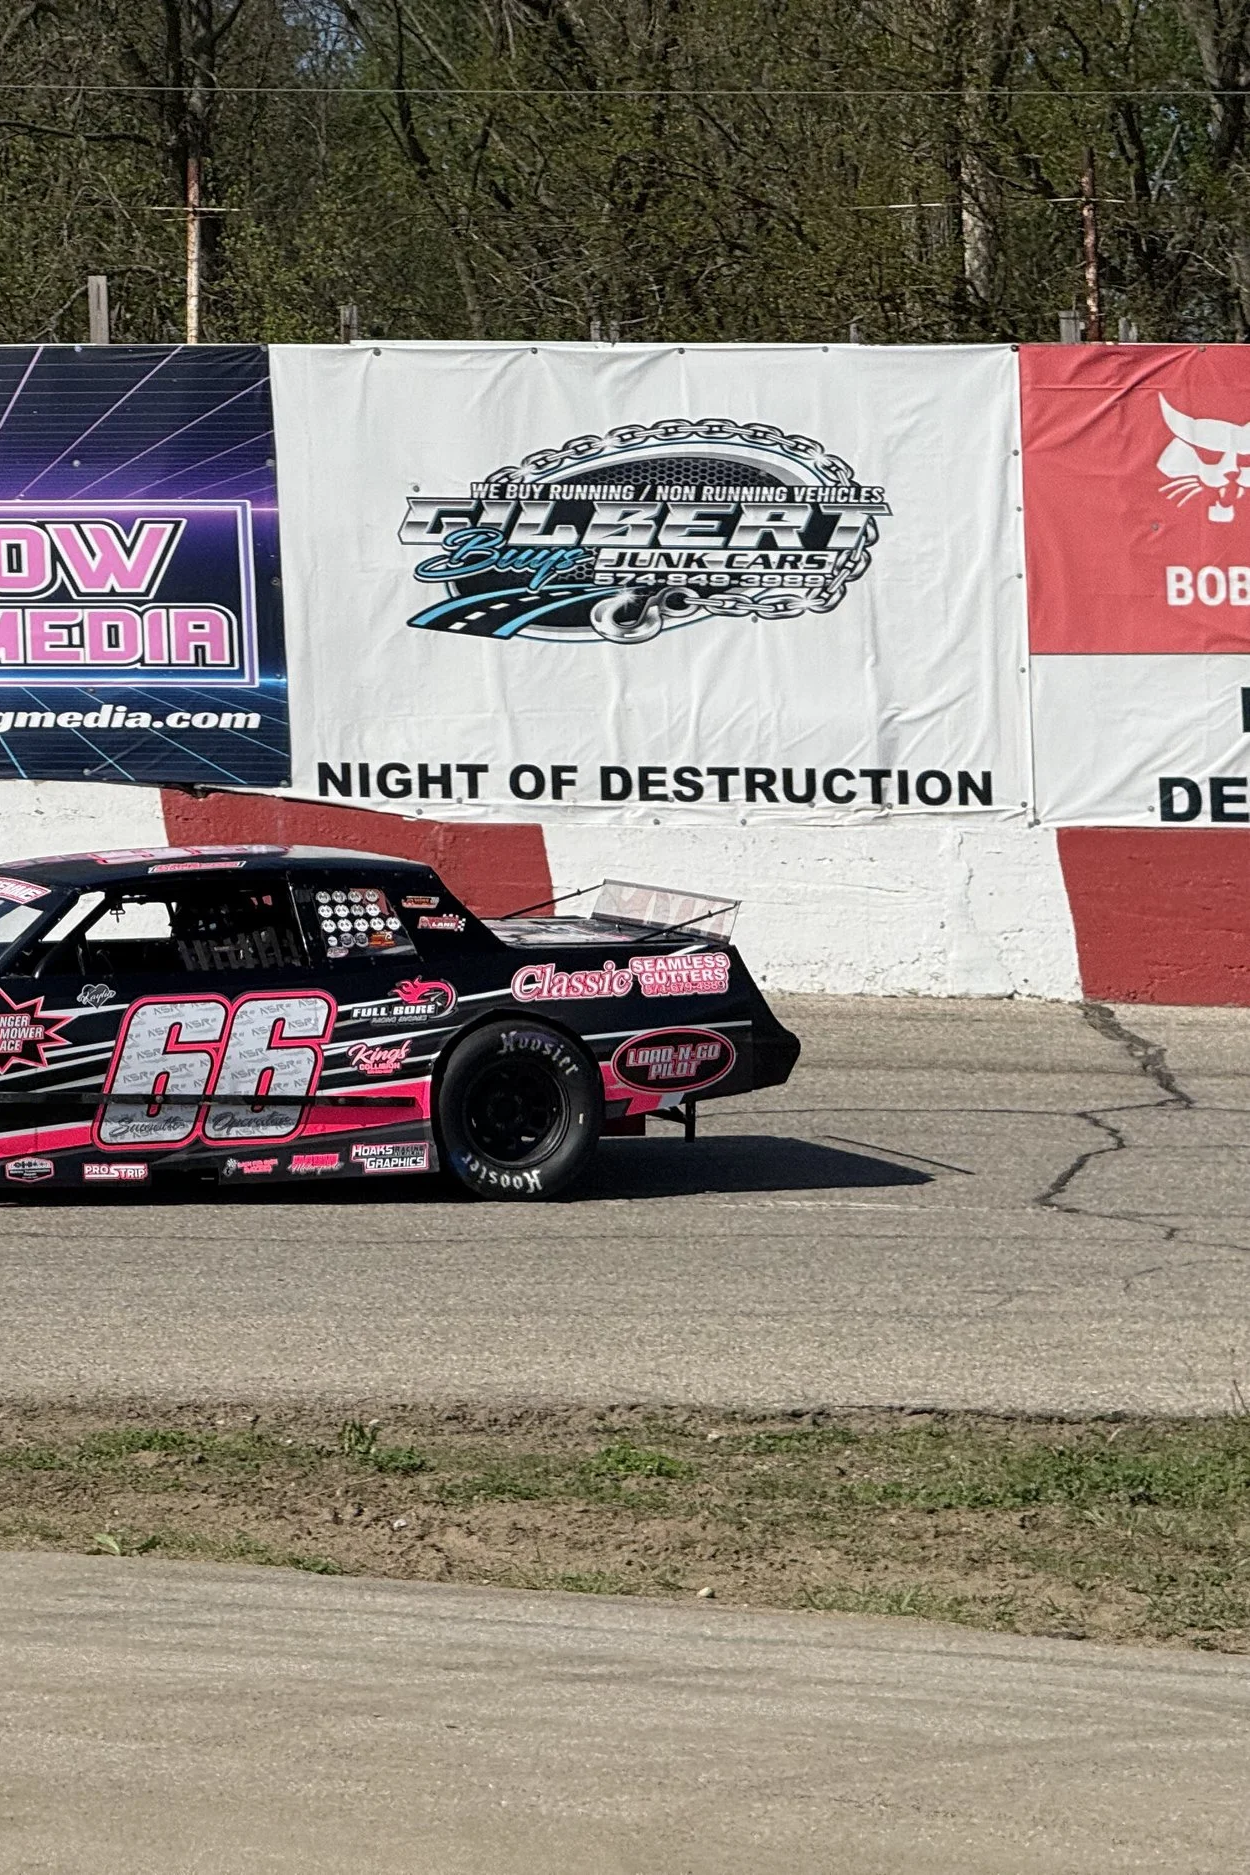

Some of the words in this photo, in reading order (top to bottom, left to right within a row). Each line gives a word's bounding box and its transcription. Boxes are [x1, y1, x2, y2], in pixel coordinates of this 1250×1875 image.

[472, 484, 501, 500] WE
[505, 484, 546, 500] BUY
[549, 485, 636, 501] RUNNING
[656, 485, 695, 501] NON
[702, 486, 787, 502] RUNNING
[793, 487, 885, 503] VEHICLES
[398, 497, 893, 549] GILBERT
[414, 527, 595, 593] Buys
[603, 551, 708, 569] JUNK
[724, 552, 830, 571] CARS
[594, 572, 827, 588] 574-849-3989
[1166, 565, 1250, 607] BOB
[318, 762, 489, 800] NIGHT
[509, 764, 579, 801] OF
[600, 766, 995, 807] DESTRUCTION
[1158, 777, 1250, 823] DE
[632, 954, 728, 973] SEAMLESS
[512, 961, 634, 1002] Classic
[640, 969, 726, 985] GUTTERS
[352, 1006, 388, 1018] FULL
[392, 1004, 436, 1016] BORE
[0, 1026, 44, 1040] MOWER
[499, 1031, 579, 1076] Hoosier
[92, 988, 338, 1152] 66
[648, 1060, 700, 1080] PILOT
[352, 1144, 393, 1157] HOAKS
[366, 1156, 424, 1169] GRAPHICS
[462, 1152, 543, 1194] Hoosier
